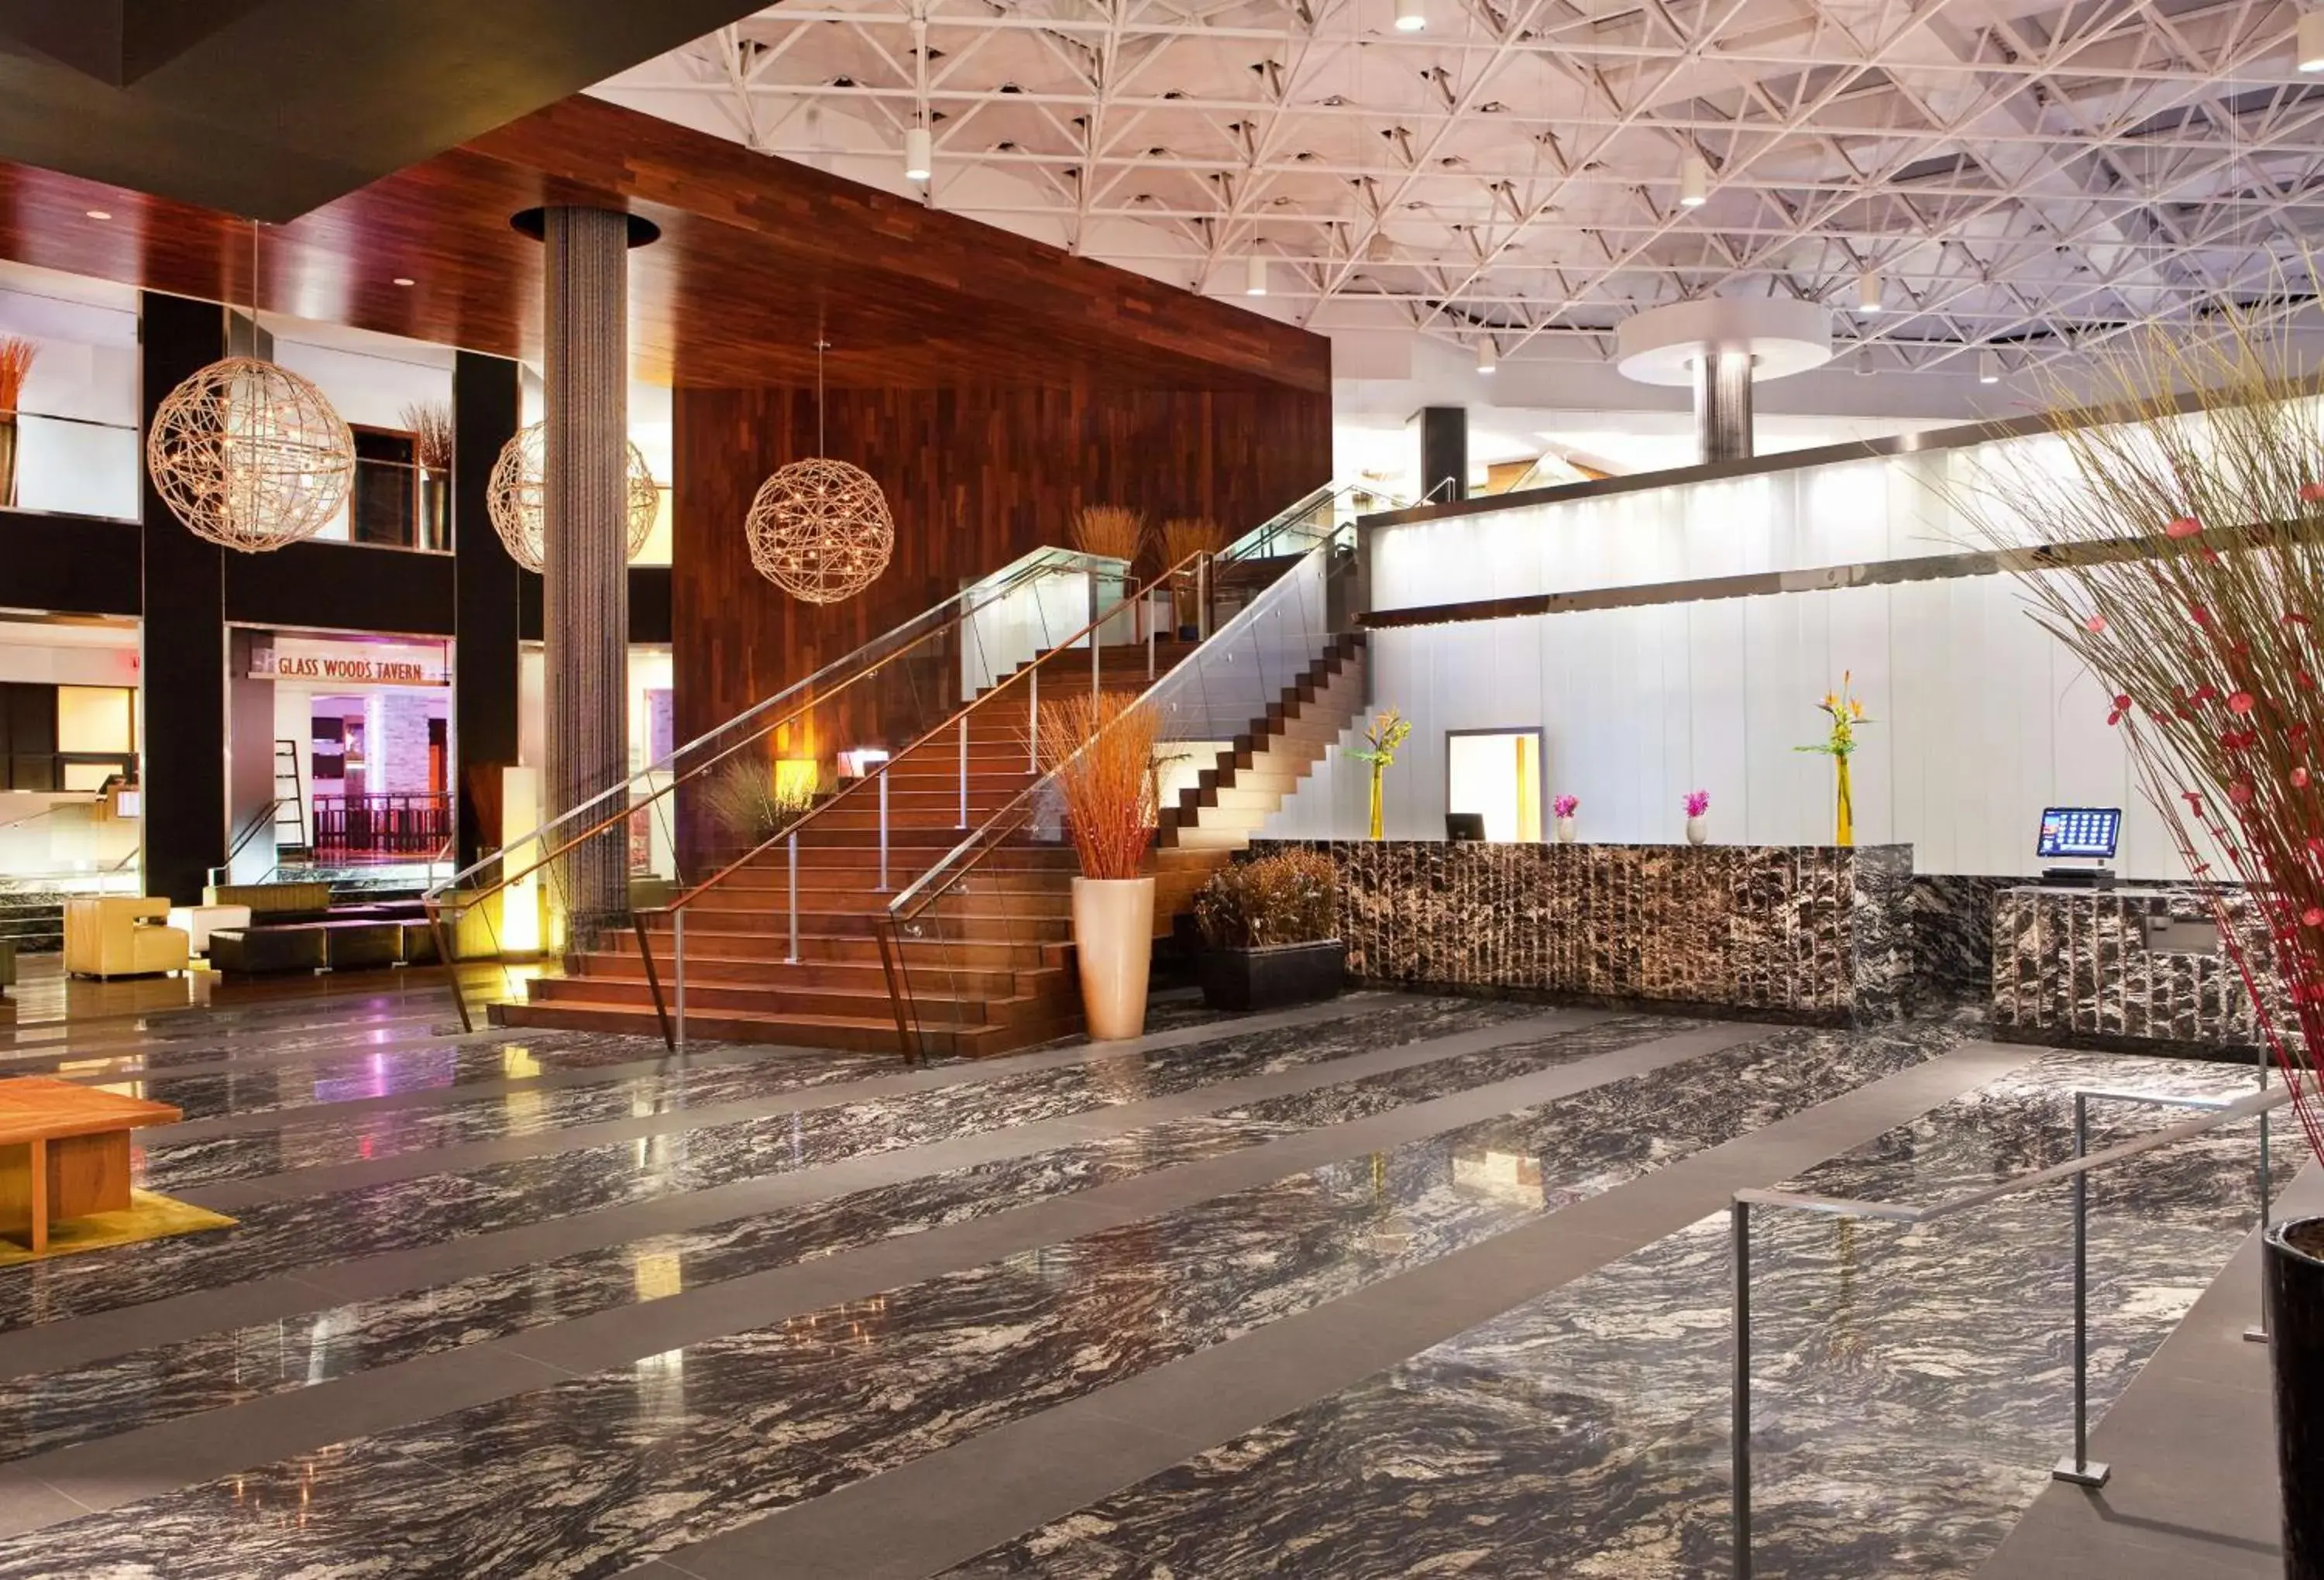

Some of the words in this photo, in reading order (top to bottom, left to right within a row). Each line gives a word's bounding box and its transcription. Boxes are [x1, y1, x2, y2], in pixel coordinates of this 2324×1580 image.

[279, 658, 318, 676] GLASS
[324, 660, 372, 678] WOODS
[376, 662, 421, 680] TAVERN
